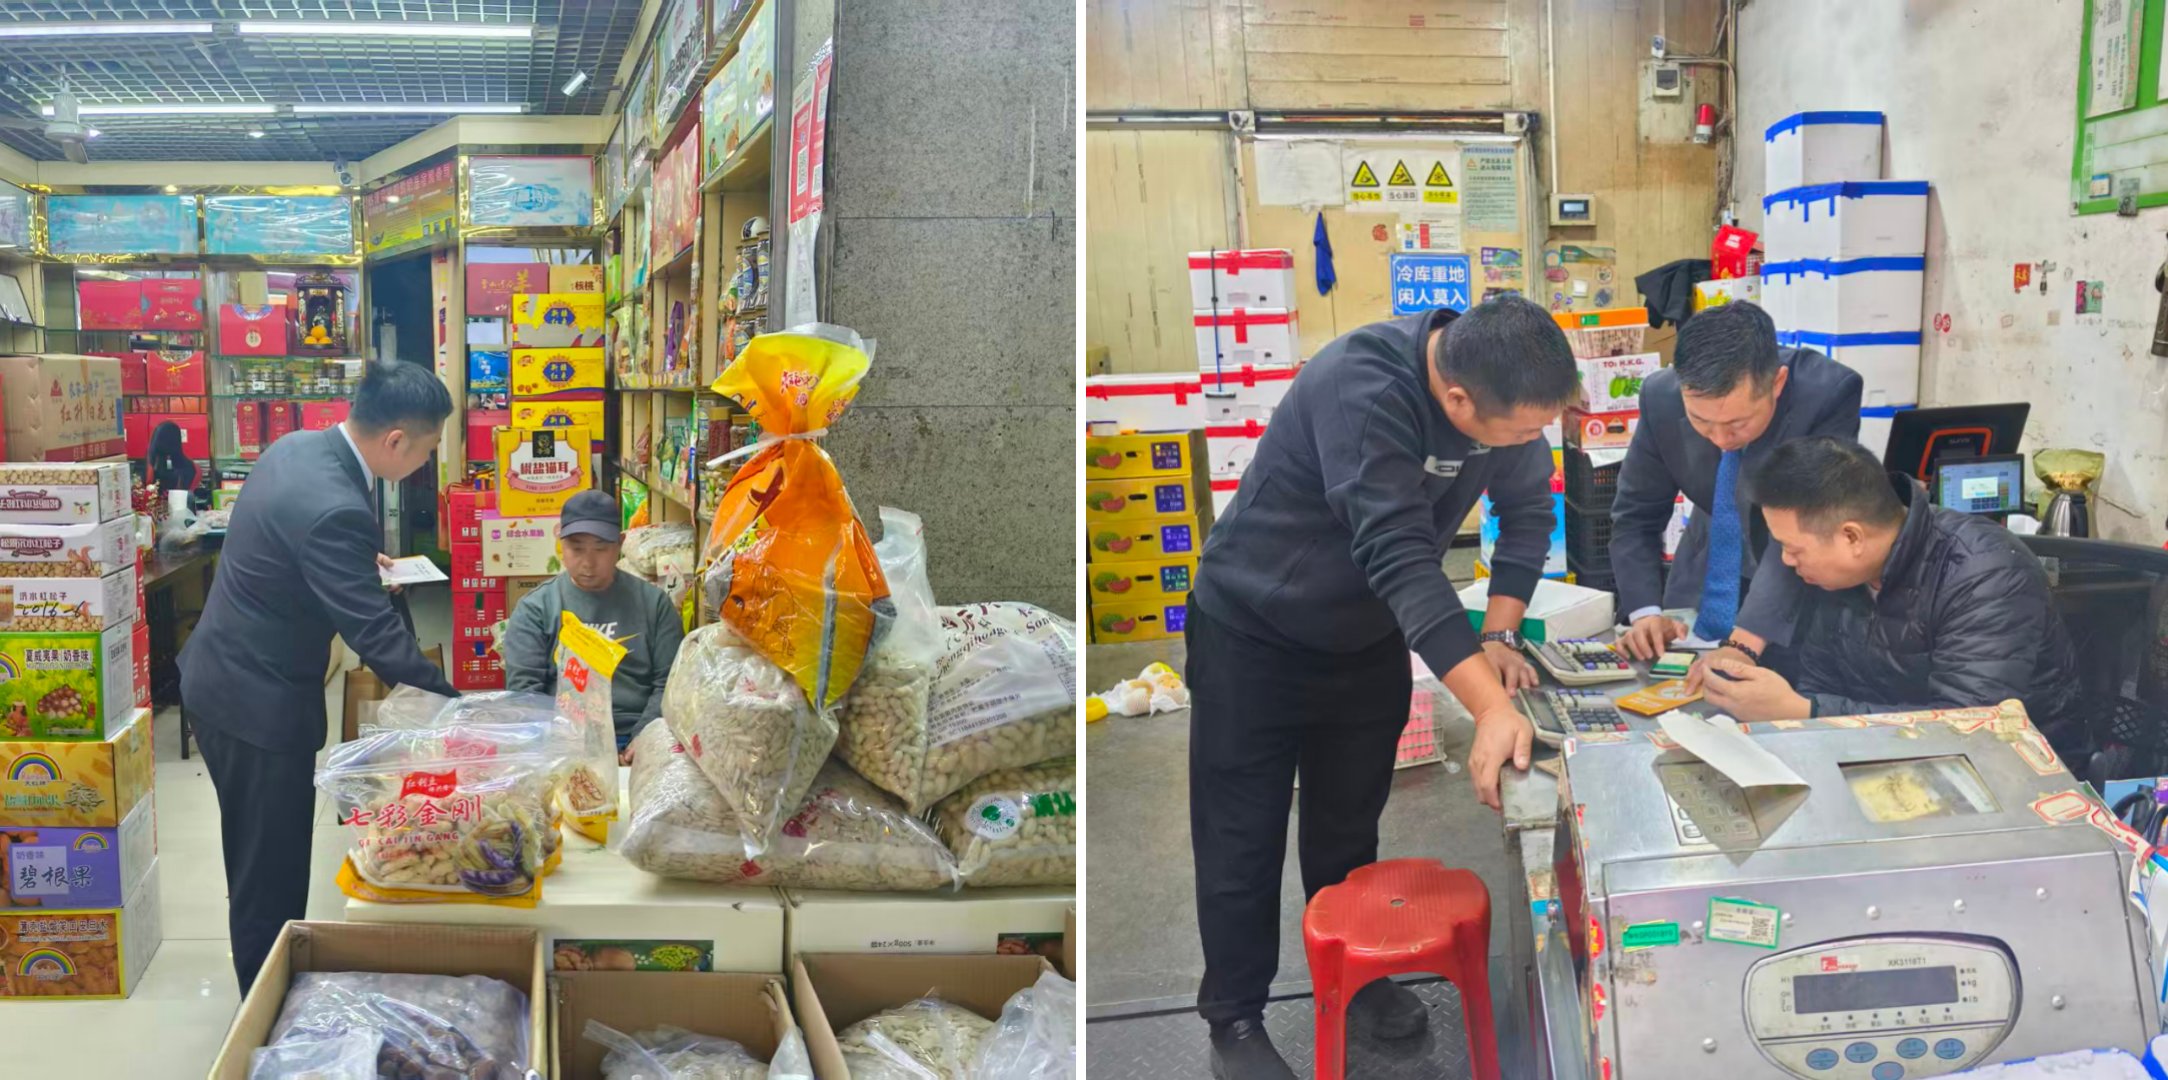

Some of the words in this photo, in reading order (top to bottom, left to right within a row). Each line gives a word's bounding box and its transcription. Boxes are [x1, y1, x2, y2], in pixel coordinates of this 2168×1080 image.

[1396, 265, 1466, 283] 冷库重地
[575, 281, 594, 291] 核桃
[1398, 288, 1466, 306] 闲人莫入
[521, 461, 569, 475] 椒盐猫耳
[26, 649, 60, 662] 夏威夷果
[63, 649, 90, 662] 奶香味
[344, 794, 482, 829] 七彩金刚
[378, 836, 399, 845] CAI
[403, 835, 421, 844] JIN
[426, 832, 459, 842] GANG
[16, 851, 44, 860] 奶香味
[19, 864, 93, 890] 碧根果
